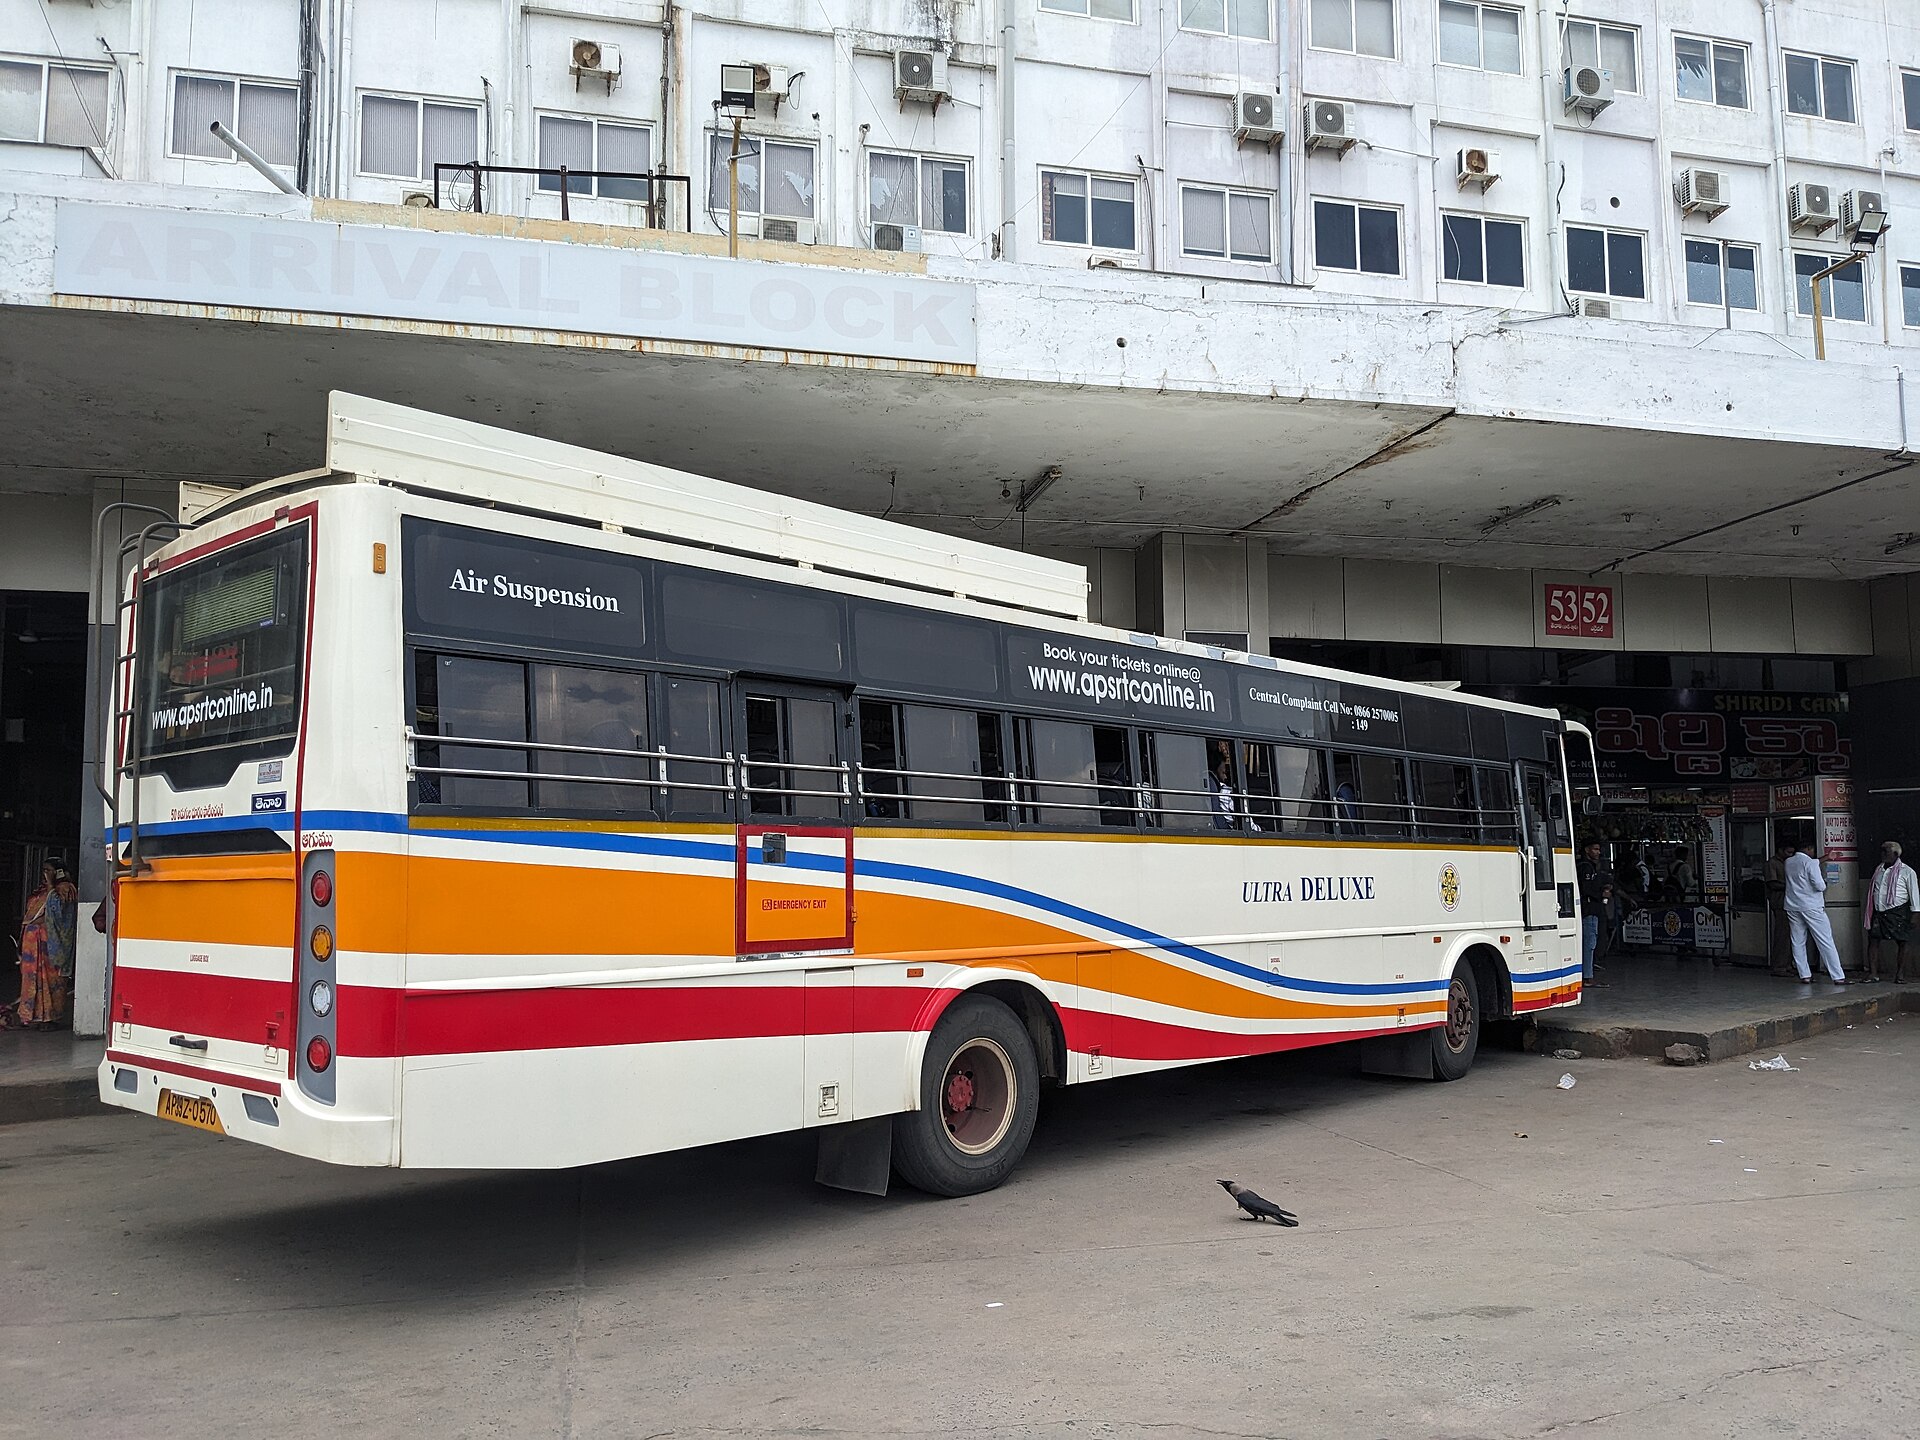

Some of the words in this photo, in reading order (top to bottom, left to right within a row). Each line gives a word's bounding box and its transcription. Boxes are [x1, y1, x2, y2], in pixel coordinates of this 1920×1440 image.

[75, 216, 581, 314] ARRIVAL
[618, 263, 958, 348] BLOCK
[449, 568, 489, 594] Air
[493, 573, 620, 613] Suspension
[1550, 590, 1578, 622] 53
[1582, 592, 1609, 624] 52
[1043, 641, 1078, 662] Book
[1079, 650, 1109, 668] your
[1110, 653, 1151, 673] tickets
[1153, 661, 1201, 683] online@
[1028, 665, 1215, 712] www.apsrtconline.in
[1248, 686, 1281, 706] Central
[1282, 692, 1323, 712] Complaint
[1323, 699, 1339, 714] Cell
[1339, 701, 1353, 716] No:
[1353, 704, 1371, 719] 0866
[1713, 695, 1793, 713] SHIRIDI
[152, 682, 273, 730] www.apsrtconline.in
[1356, 718, 1369, 732] 149
[255, 797, 282, 809] తెనాలి
[1775, 783, 1810, 797] TENALI
[773, 900, 811, 910] EMERGENCY
[813, 899, 827, 909] EXIT
[1242, 881, 1293, 904] ULTRA
[1300, 876, 1376, 902] DELUXE
